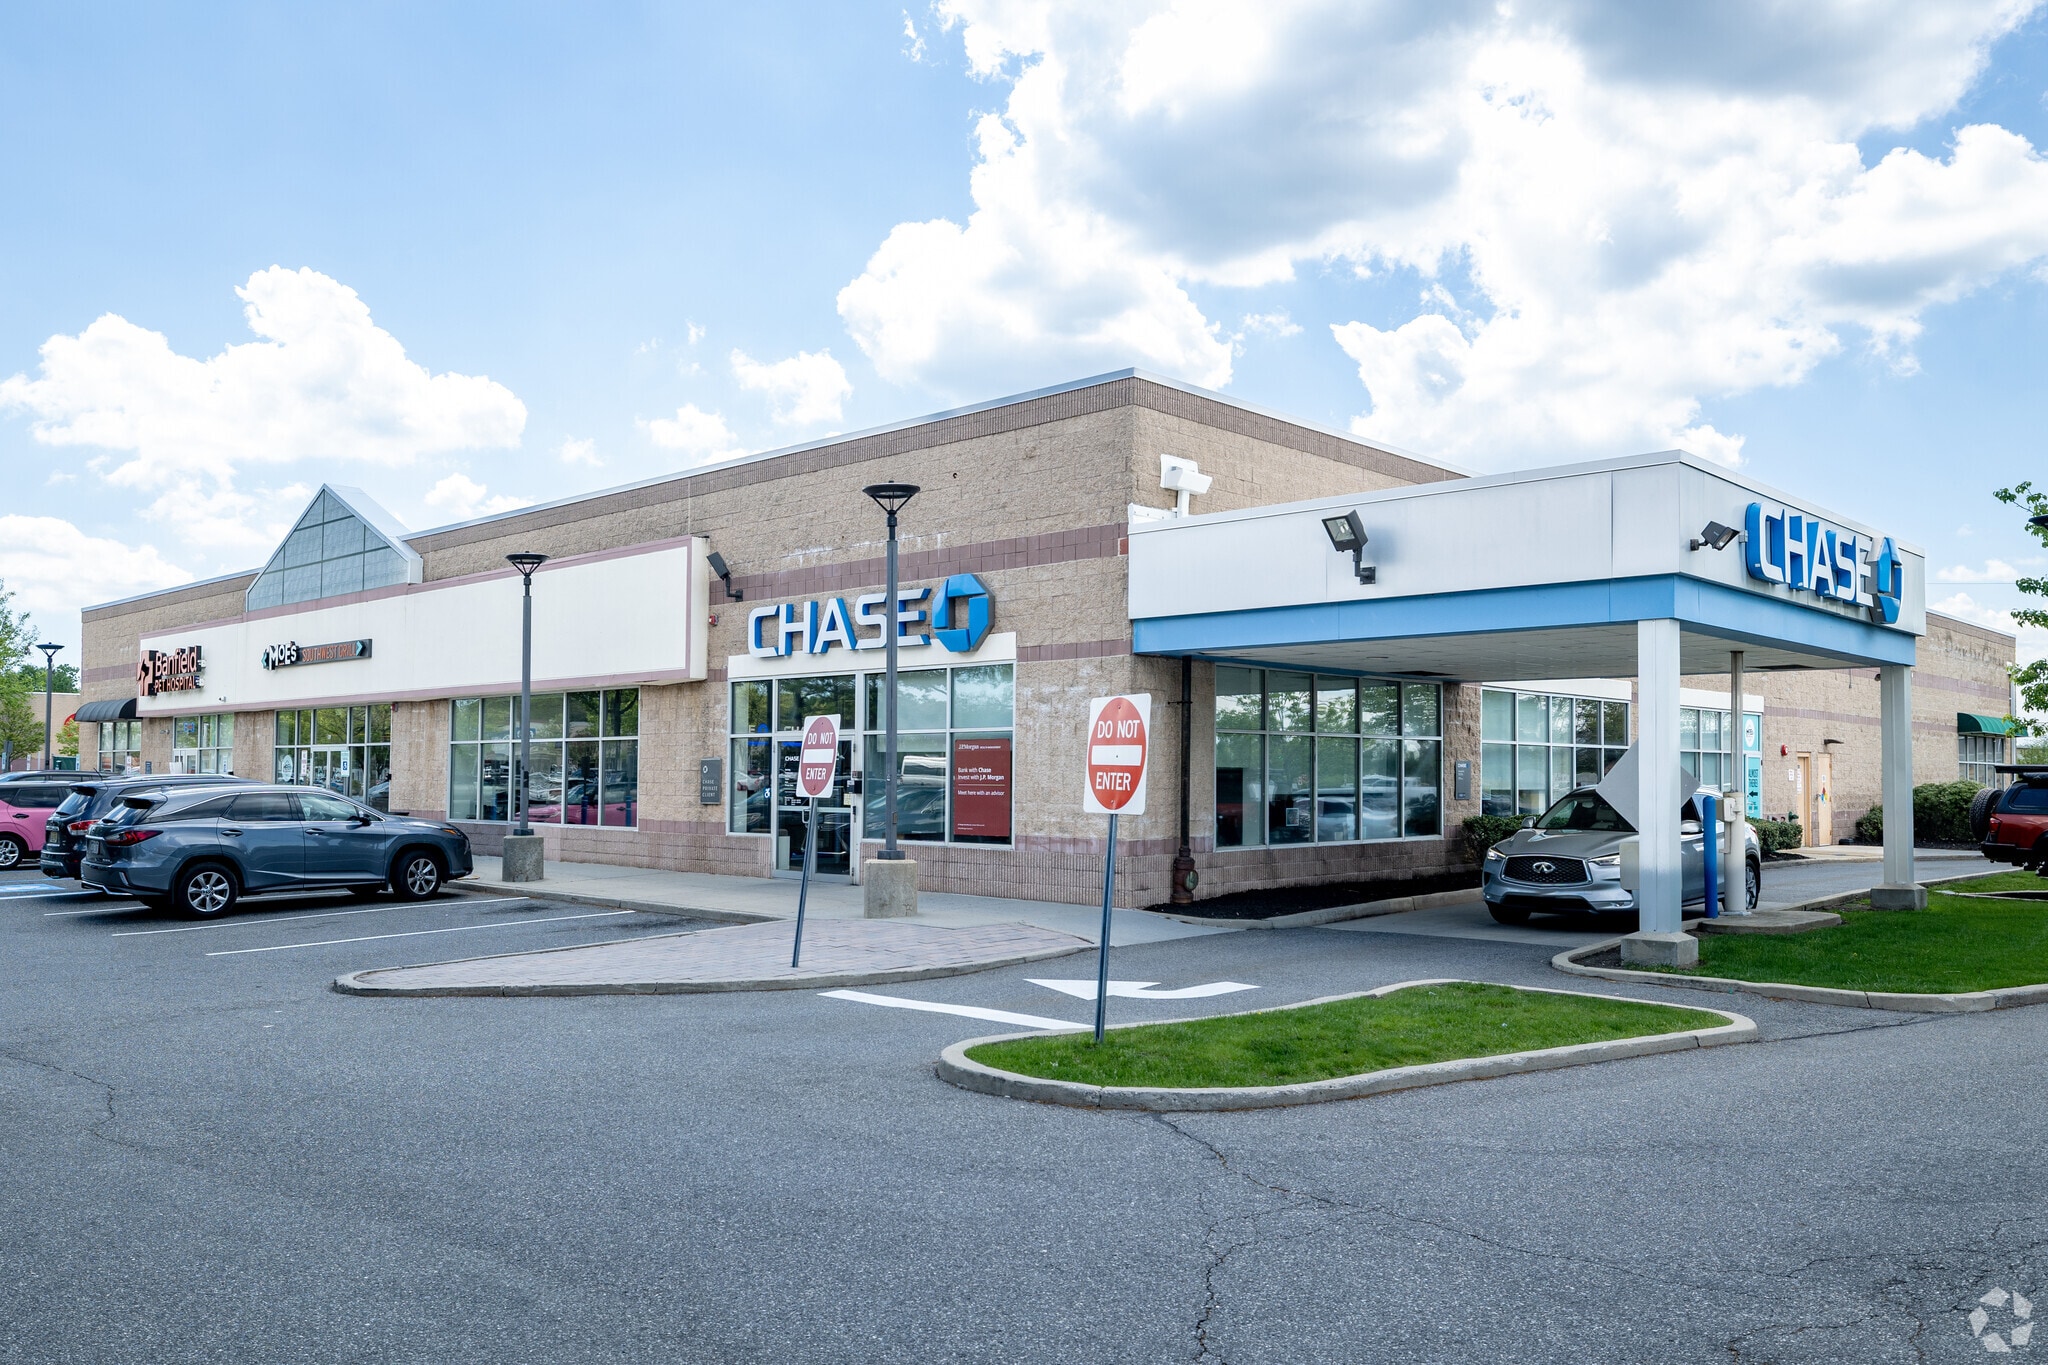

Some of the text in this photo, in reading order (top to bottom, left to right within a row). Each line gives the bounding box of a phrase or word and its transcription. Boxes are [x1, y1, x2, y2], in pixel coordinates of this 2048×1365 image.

[1745, 502, 1873, 607] CHASE
[748, 588, 931, 658] CHASE
[155, 645, 200, 677] Banfield
[302, 645, 338, 662] SOUTHWEST
[339, 641, 356, 657] GRILL
[154, 675, 196, 693] PET HOSPITAL
[807, 732, 833, 745] DO NOT
[1097, 719, 1140, 739] DO NOT
[805, 767, 827, 780] ENTER
[1095, 771, 1132, 791] ENTER
